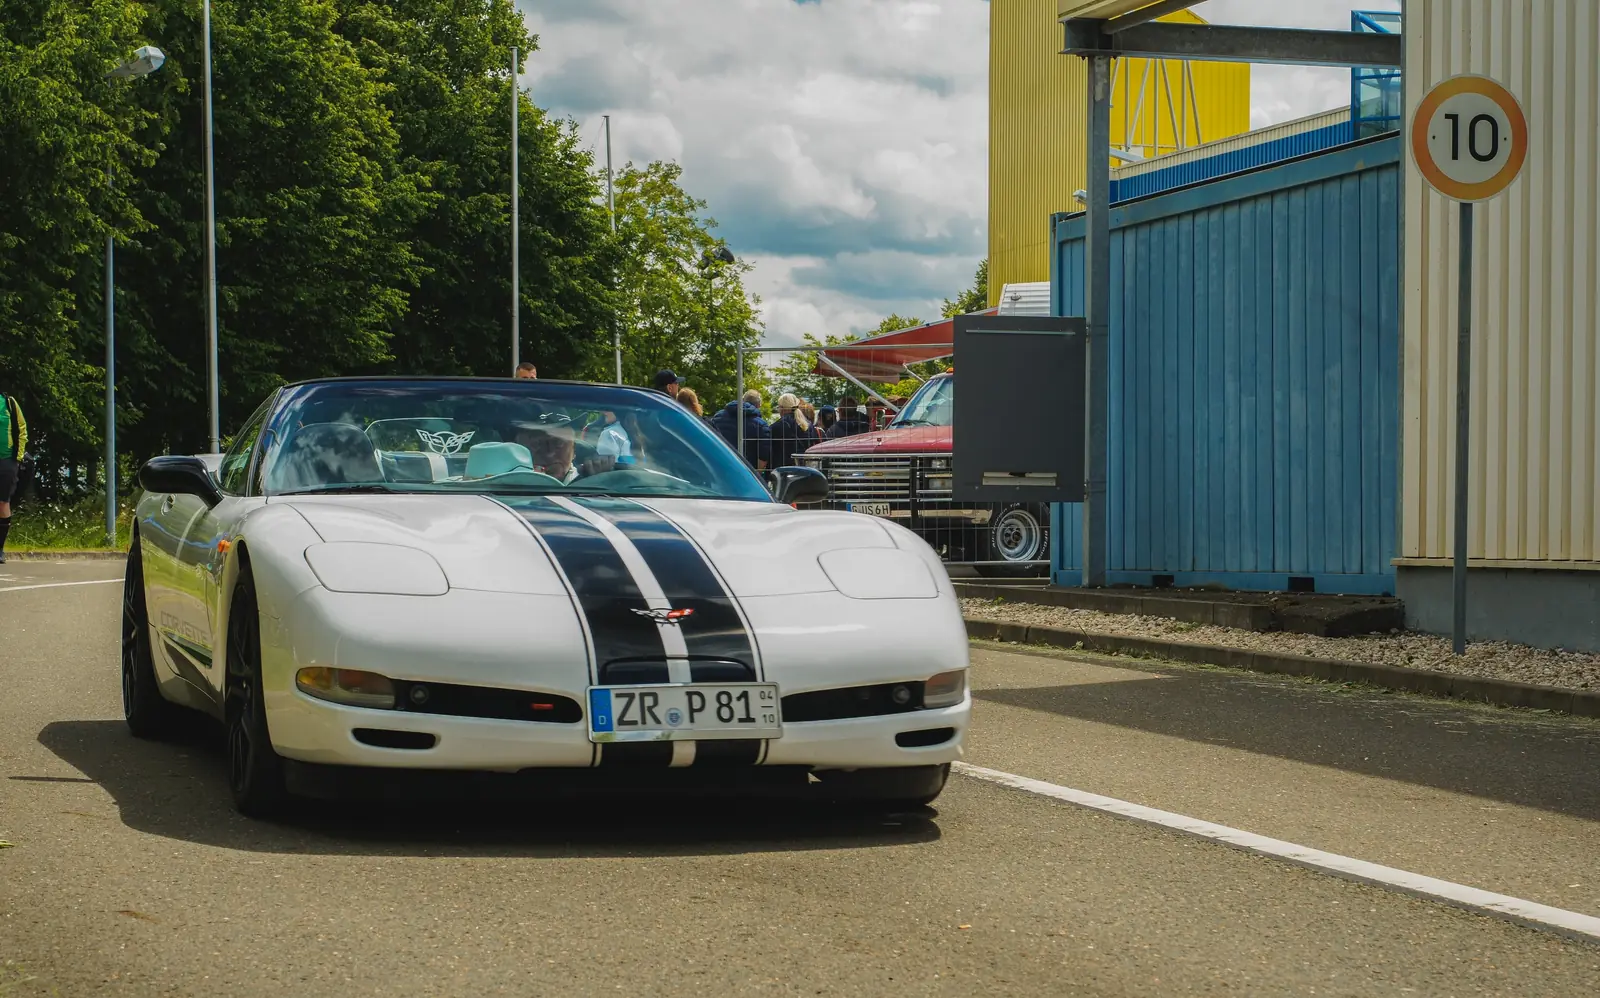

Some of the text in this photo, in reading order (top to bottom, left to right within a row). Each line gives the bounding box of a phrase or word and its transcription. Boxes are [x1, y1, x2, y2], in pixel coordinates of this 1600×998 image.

[1444, 113, 1499, 162] 10
[875, 504, 889, 515] 6H
[760, 690, 773, 700] 04
[615, 690, 756, 725] ZR P 81
[598, 715, 607, 725] D
[763, 713, 775, 723] 10
